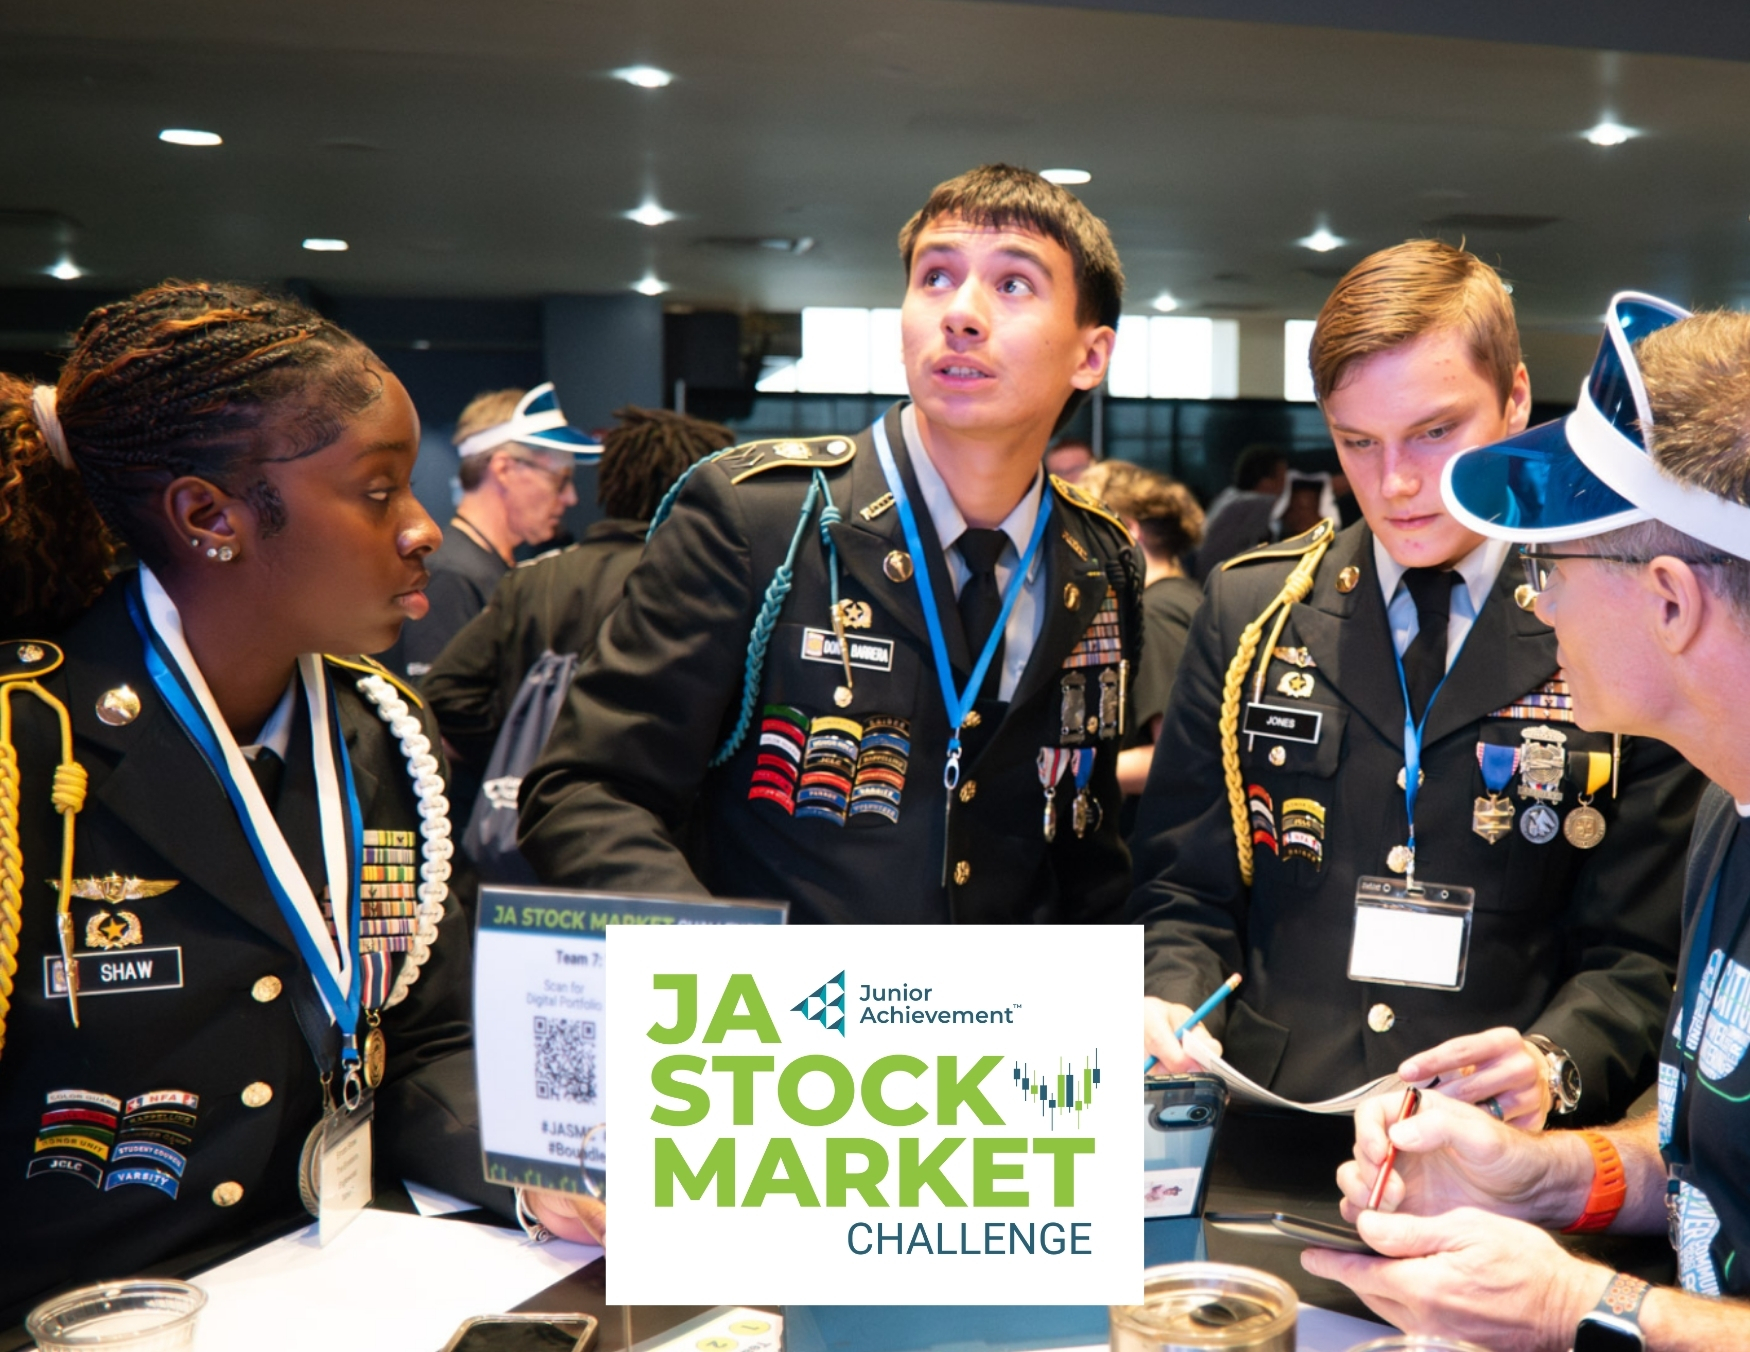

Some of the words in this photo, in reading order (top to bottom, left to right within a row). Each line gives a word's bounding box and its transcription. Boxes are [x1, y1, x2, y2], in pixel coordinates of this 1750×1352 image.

[850, 643, 888, 662] BARRERA
[1266, 716, 1296, 728] JONES
[494, 905, 516, 925] JA
[522, 908, 585, 930] STOCK
[557, 950, 587, 966] Team
[100, 960, 153, 982] SHAW
[544, 979, 566, 993] Scan
[570, 982, 584, 994] for
[527, 992, 556, 1008] Digital
[149, 1094, 176, 1103] NFA
[41, 1138, 78, 1146] HONOR
[80, 1141, 104, 1153] UNIT
[118, 1145, 154, 1155] STUDENT
[50, 1160, 83, 1172] JCLC
[117, 1172, 169, 1187] VARSITY
